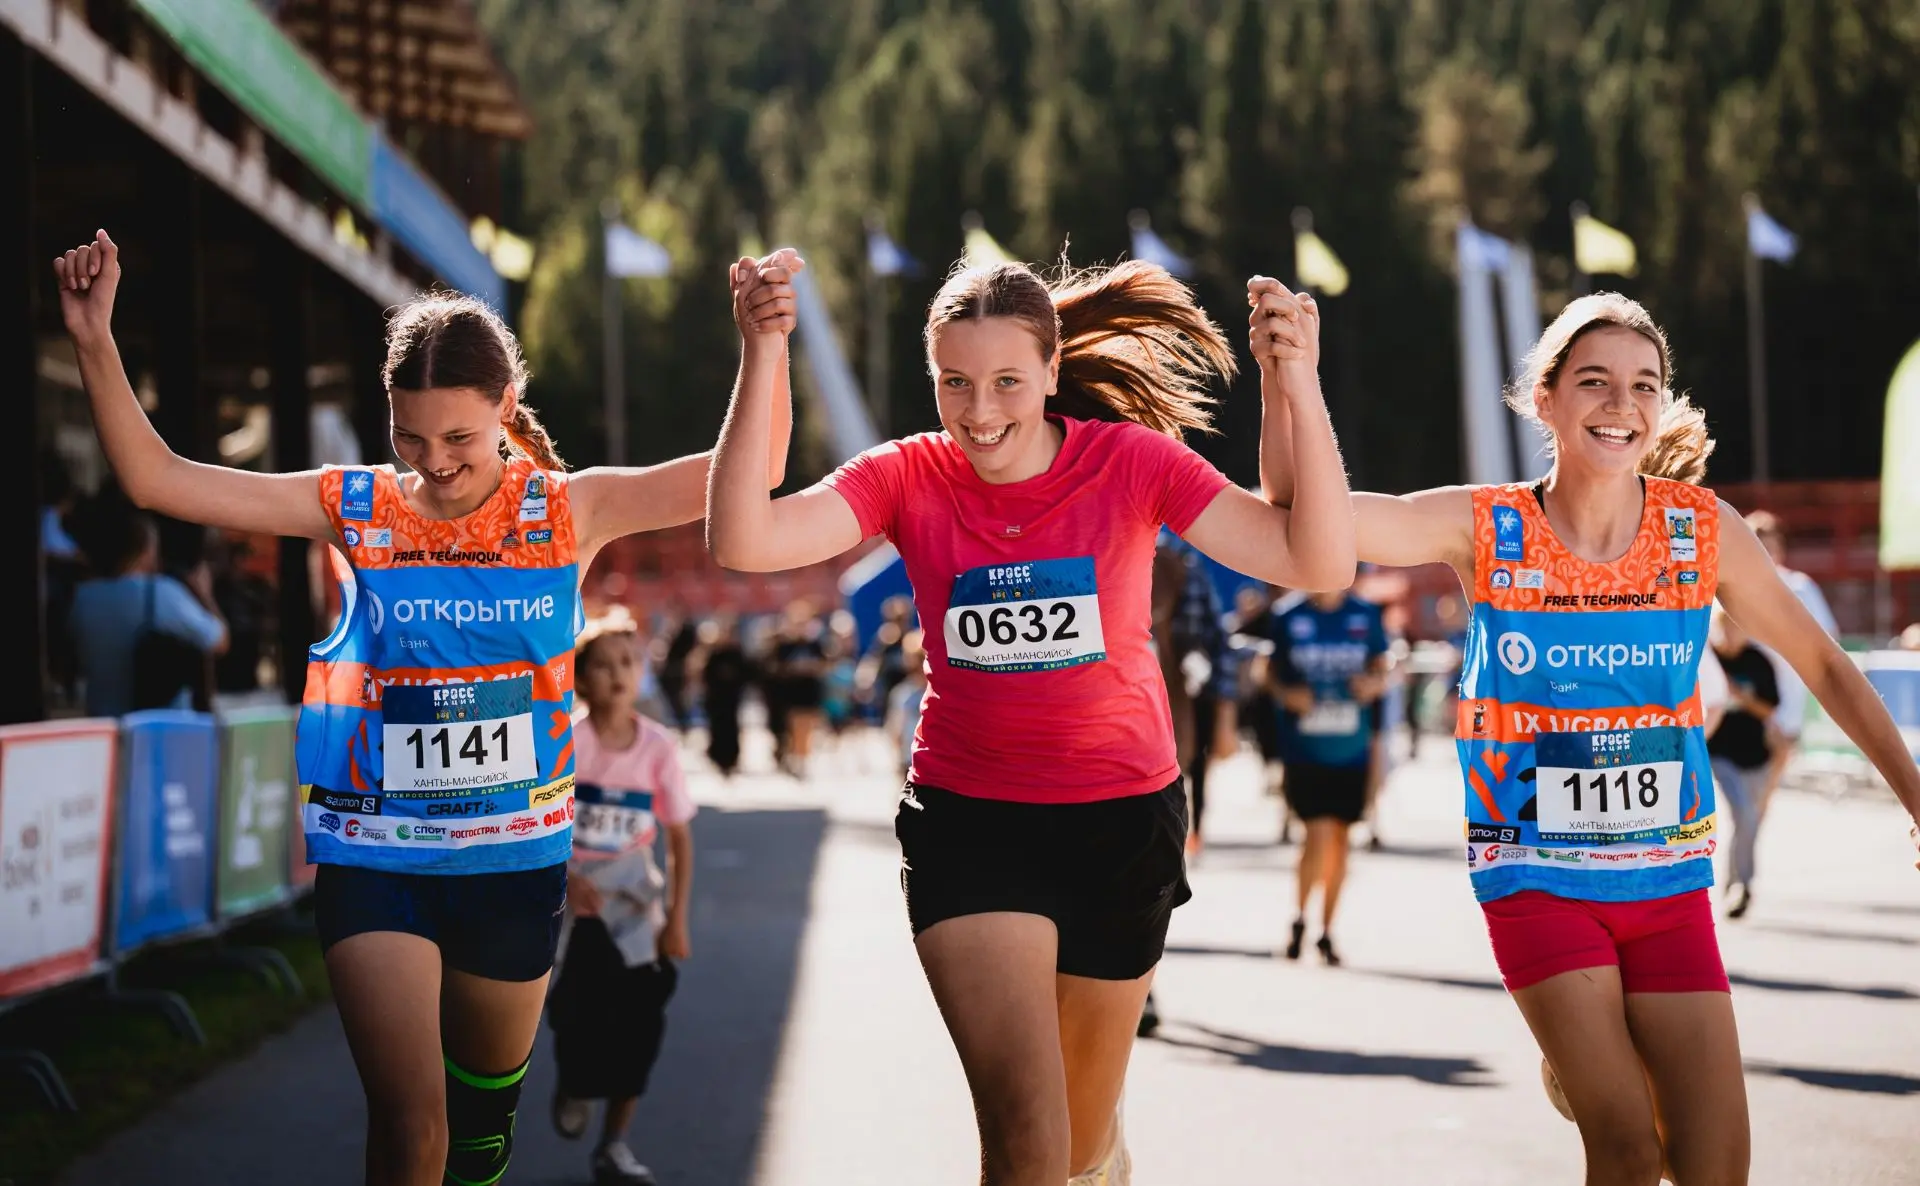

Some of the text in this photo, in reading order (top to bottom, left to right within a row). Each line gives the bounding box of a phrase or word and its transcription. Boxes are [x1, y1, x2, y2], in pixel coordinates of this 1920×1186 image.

[392, 550, 503, 564] FREE TECHNIQUE
[988, 566, 1031, 581] КРОСС
[989, 577, 1032, 586] НАЦИИ
[1544, 593, 1657, 607] FREE TECHNIQUE
[393, 594, 554, 629] открытие
[958, 601, 1080, 648] 0632
[399, 636, 430, 650] Банк
[974, 647, 1073, 664] ХАНТЫ-МАНСИЙСК
[1546, 640, 1694, 675] открытие
[950, 659, 1033, 672] ВСЕРОССИЙСКИЙ
[1043, 660, 1070, 670] ДЕНЬ
[433, 686, 476, 701] КРОСС
[434, 697, 476, 707] НАЦИИ
[406, 722, 508, 769] 1141
[1591, 733, 1631, 747] КРОСС
[1592, 744, 1631, 753] НАЦИИ
[413, 771, 508, 789] ХАНТЫ-МАНСИЙСК
[385, 789, 472, 799] ВСЕРОССИЙСКИЙ
[481, 786, 505, 796] ДЕНЬ
[533, 781, 570, 804] FISCHER
[1563, 768, 1659, 813] 1118
[427, 801, 483, 816] CRAFT
[1568, 816, 1656, 831] ХАНТЫ-МАНСИЙСК
[414, 825, 447, 835] СПОРТ
[450, 826, 500, 839] РОСГОССТРАХ
[1541, 833, 1626, 841] ВСЕРОССИЙСКИЙ
[1633, 831, 1654, 840] ДЕНЬ
